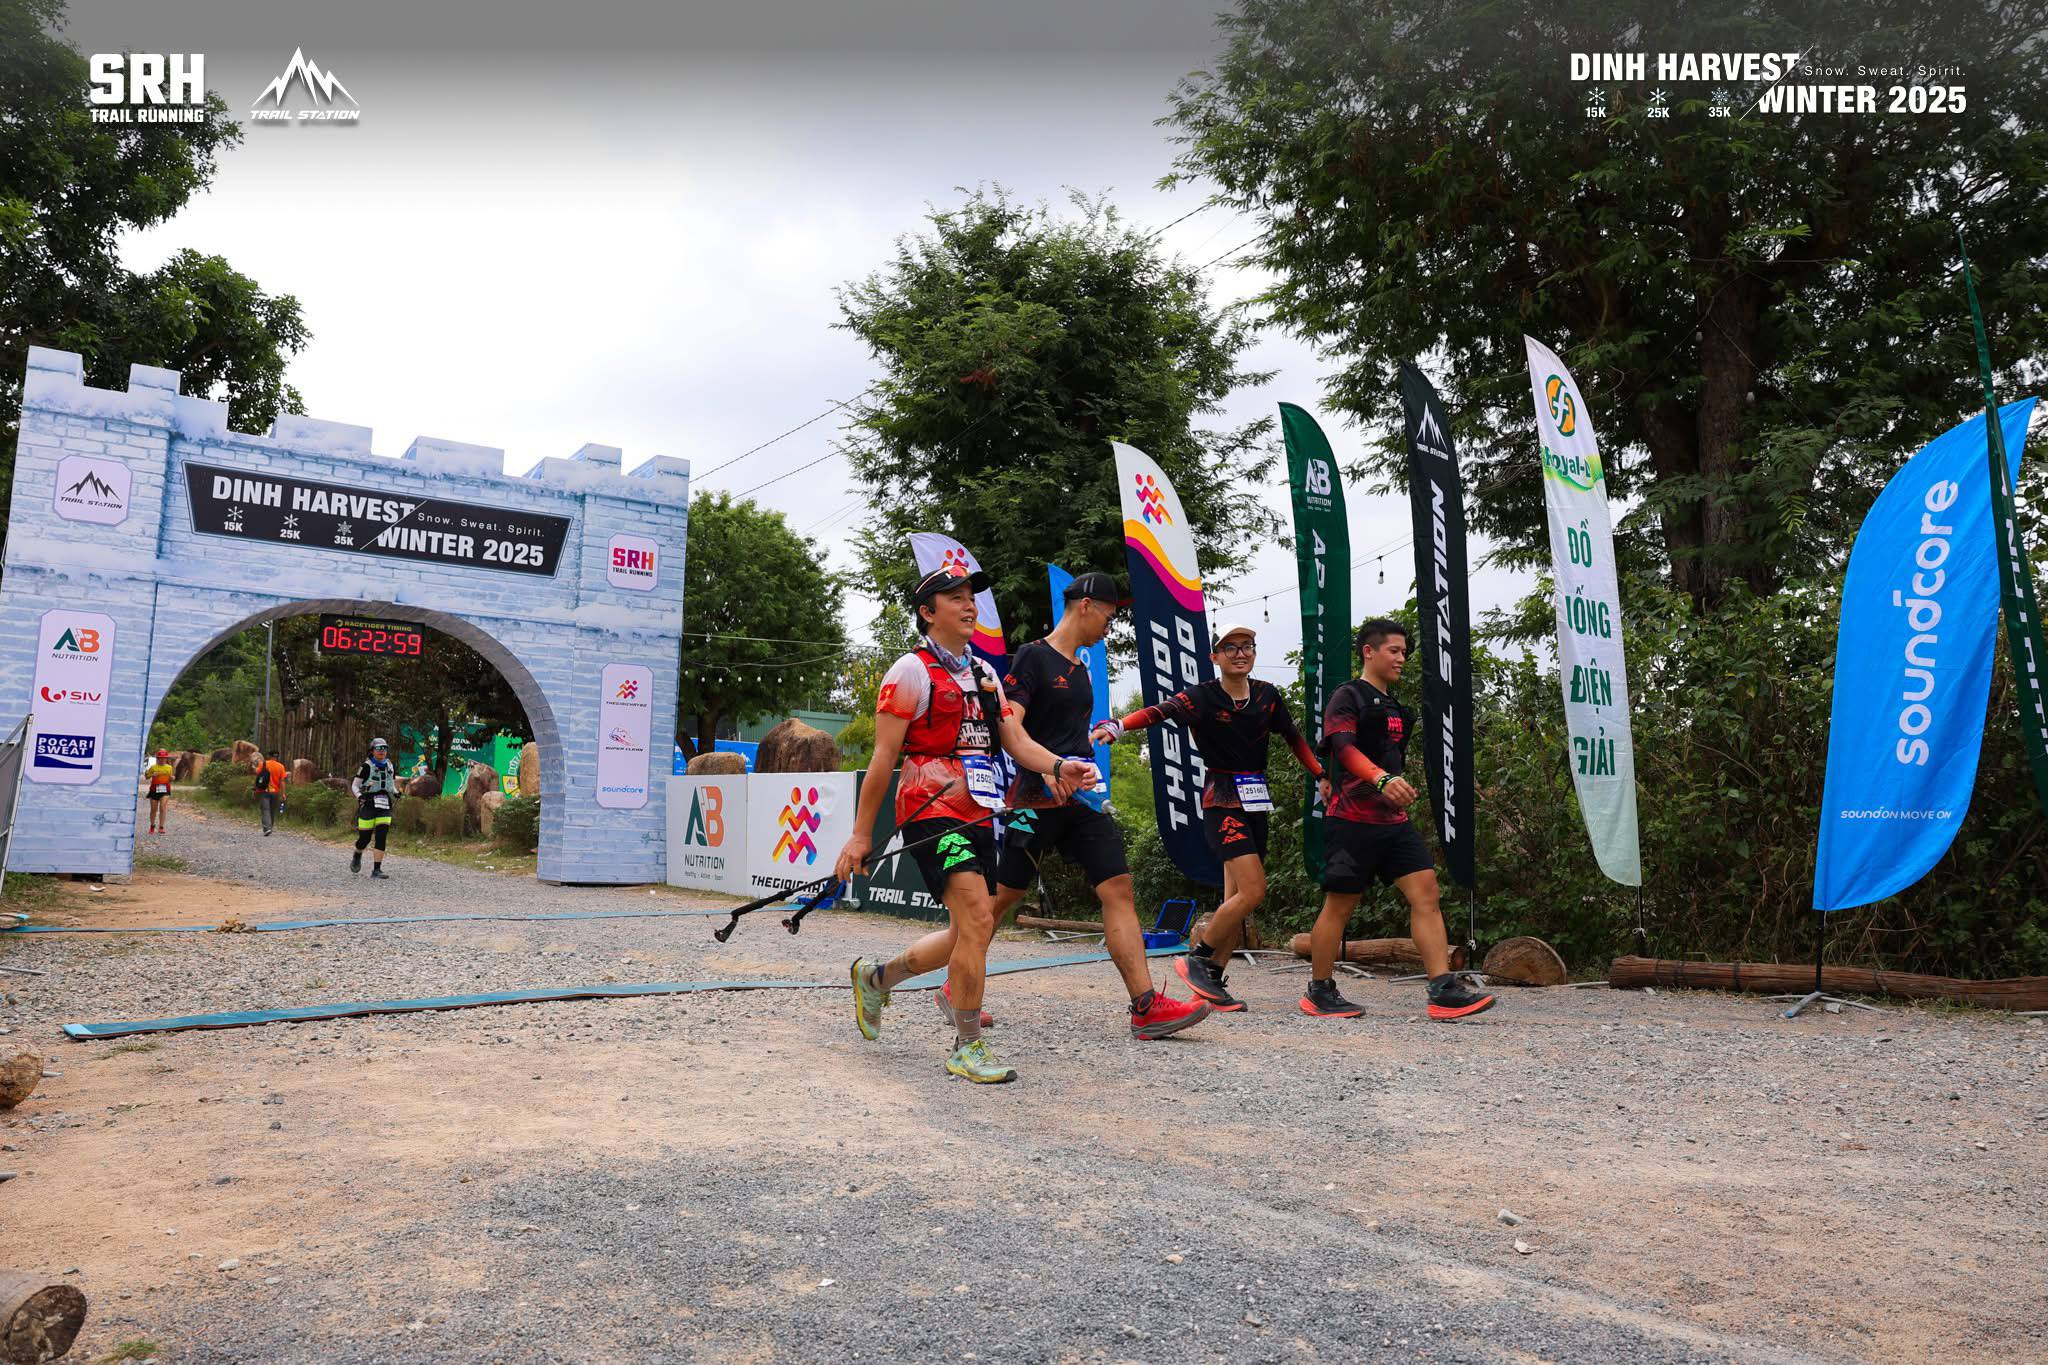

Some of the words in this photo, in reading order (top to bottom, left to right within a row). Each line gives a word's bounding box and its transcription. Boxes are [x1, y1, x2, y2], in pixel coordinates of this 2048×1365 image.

[60, 496, 84, 504] TRAIL
[87, 500, 122, 509] STATION
[212, 475, 283, 508] DINH
[292, 487, 416, 523] HARVEST
[223, 520, 243, 533] 15K
[280, 528, 301, 540] 25K
[417, 512, 453, 526] Snow.
[460, 518, 501, 531] Sweat.
[508, 524, 545, 537] Spirit.
[334, 534, 354, 547] 35K
[376, 526, 474, 559] WINTER
[482, 538, 545, 567] 2025
[612, 547, 654, 570] SRH
[1430, 478, 1452, 687] STATION
[1893, 479, 1959, 767] soundcore
[53, 627, 100, 653] AB
[323, 626, 422, 655] 06:22:59
[51, 653, 99, 662] NUTRITION
[1570, 657, 1613, 714] ĐIỆN
[70, 691, 101, 702] SIV
[37, 745, 88, 756] SWEAT
[38, 737, 94, 748] POCARI
[1442, 704, 1456, 843] TRAIL
[602, 784, 643, 794] soundcore
[684, 785, 725, 848] AB
[1900, 810, 1934, 820] MOVE
[684, 854, 725, 870] NUTRITION
[869, 886, 906, 905] TRAIL
